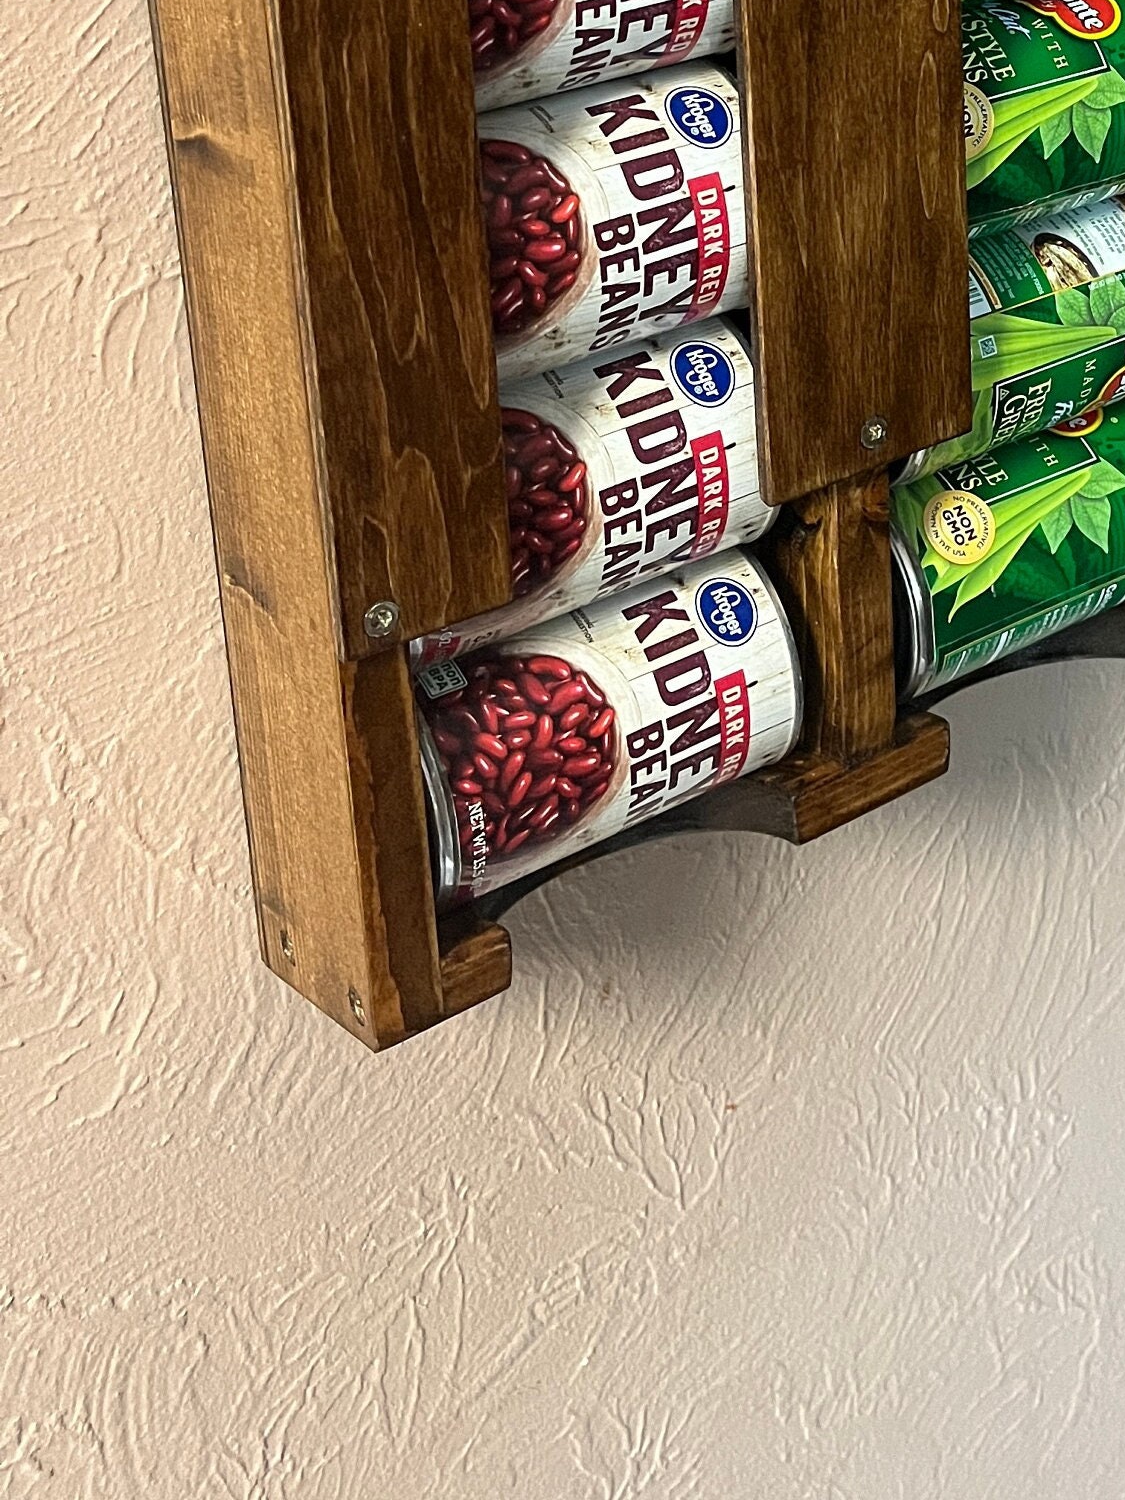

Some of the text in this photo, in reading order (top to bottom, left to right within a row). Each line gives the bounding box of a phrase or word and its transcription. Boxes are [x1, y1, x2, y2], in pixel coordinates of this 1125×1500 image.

[669, 19, 704, 53] RED
[962, 19, 1016, 82] STYLE
[1031, 18, 1069, 69] WITH
[681, 92, 716, 140] Kroger
[584, 94, 700, 322] KIDNEY
[696, 189, 723, 305] DARK RED
[588, 212, 640, 351] BEANS
[685, 348, 720, 398] Kroger
[1082, 358, 1097, 407] MADE
[592, 351, 700, 574] KIDNEY
[696, 446, 724, 555] DARK RED
[954, 504, 978, 541] NON
[966, 496, 988, 550] PRESERVATIVES
[942, 510, 970, 547] GMO
[708, 584, 744, 637] Kroger
[723, 685, 749, 750] DARK
[467, 801, 486, 832] NET
[470, 832, 489, 856] WT
